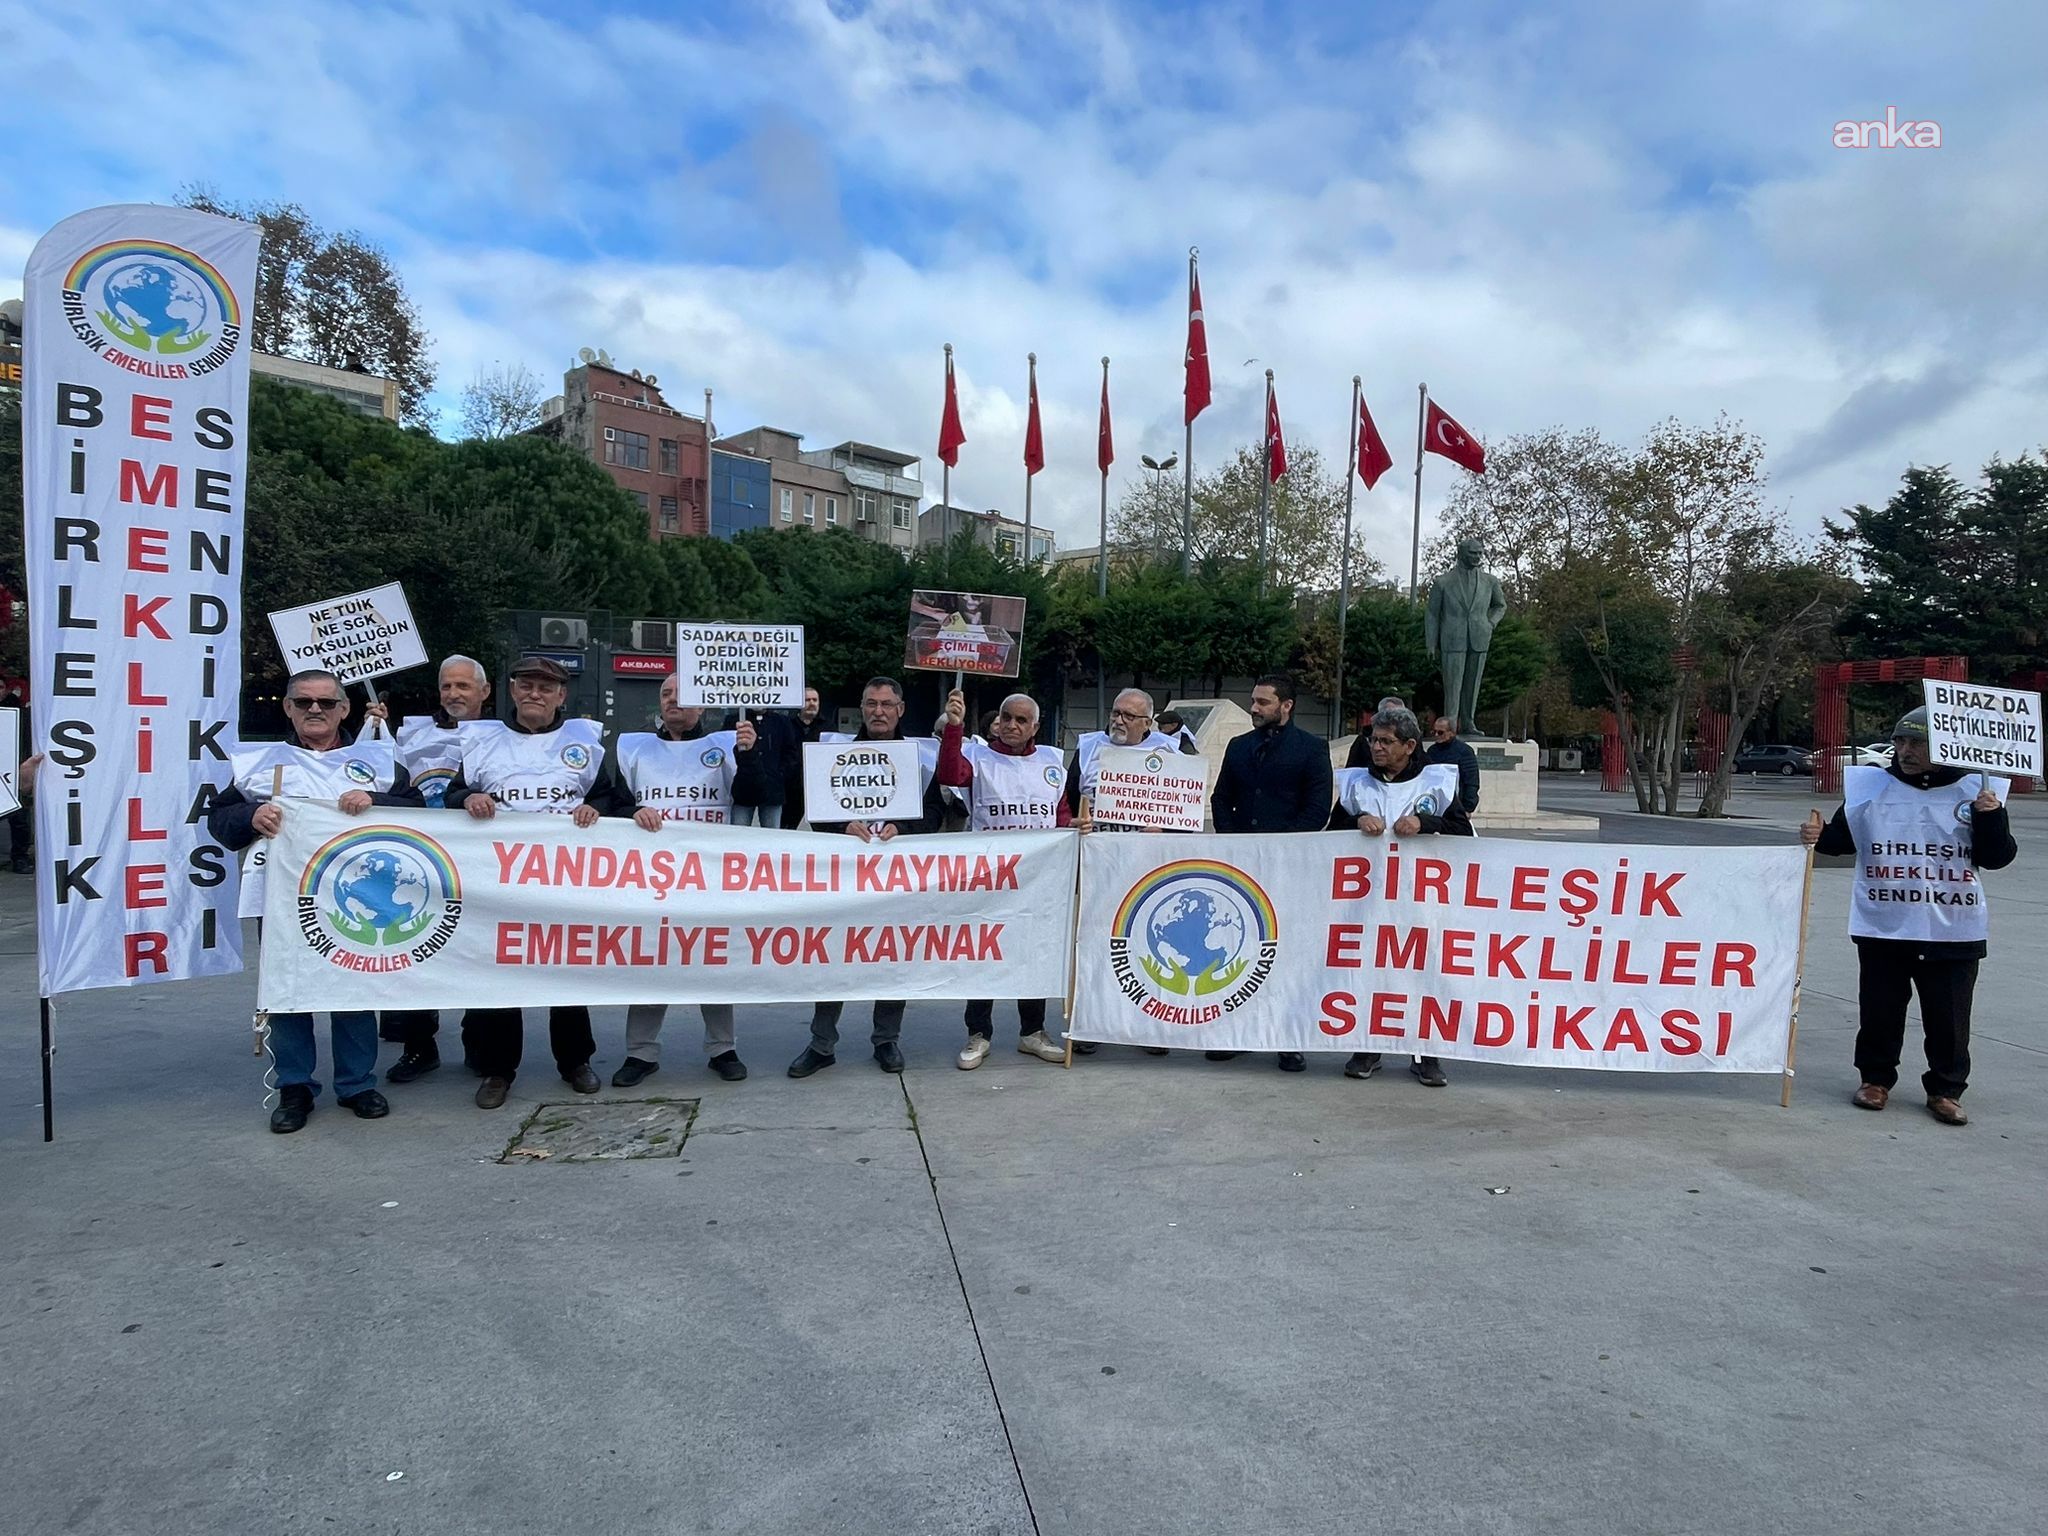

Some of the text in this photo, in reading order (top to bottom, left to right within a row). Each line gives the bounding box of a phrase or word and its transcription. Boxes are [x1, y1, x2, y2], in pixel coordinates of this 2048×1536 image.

[62, 289, 241, 379] BİRLEŞİK EMEKLİLER SENDİKASI
[308, 598, 374, 623] NE TÜİK
[317, 613, 377, 637] NE SGK
[682, 629, 799, 643] SADAKA DEĞİL
[49, 382, 104, 905] BİRLEŞİK
[291, 620, 409, 660] YOKSULLUĞUN
[694, 642, 789, 658] ÖDEDİĞİMİZ
[321, 641, 392, 669] KAYNAĞI
[620, 661, 666, 669] AKBANK
[699, 658, 784, 672] PRİMLERİN
[119, 393, 179, 978] EMEKLİLER
[185, 407, 234, 950] SENDİKASI
[694, 673, 789, 690] KARŞILIĞINI
[702, 689, 781, 705] İSTİYORUZ
[1935, 685, 2030, 715] BİRAZ DA
[1933, 712, 2037, 743] SEÇTİKLERİMİZ
[836, 753, 890, 766] SABIR
[1940, 741, 2032, 770] ŞÜKRETSİN
[831, 771, 896, 787] EMEKLİ
[1100, 769, 1203, 791] ÜLKEDEKİ BÜTÜN
[840, 796, 887, 809] OLDU
[1098, 785, 1151, 799] MARKETLERİ
[1151, 789, 1180, 803] GEZDİK
[658, 805, 724, 824] KLİLER
[989, 801, 1054, 819] BİRLEŞİ
[1116, 799, 1183, 814] MARKETTEN
[1097, 810, 1126, 821] DAHA
[1129, 813, 1174, 826] UYGUNU
[1178, 818, 1200, 828] YOK
[492, 841, 1023, 900] YANDAŞA BALLI KAYMAK
[1866, 864, 1977, 882] EMEKLİLE
[1331, 842, 1688, 928] BİRLEŞİK
[298, 896, 463, 973] BİRLEŞİK EMEKLİLER SENDİKASI
[495, 916, 1006, 967] EMEKLİYE YOK KAYNAK
[1325, 924, 1758, 988] EMEKLİLER
[1110, 938, 1278, 1025] BİRLEŞİK EMEKLİLER SENDİKASI
[1318, 990, 1733, 1057] SENDİKASI
